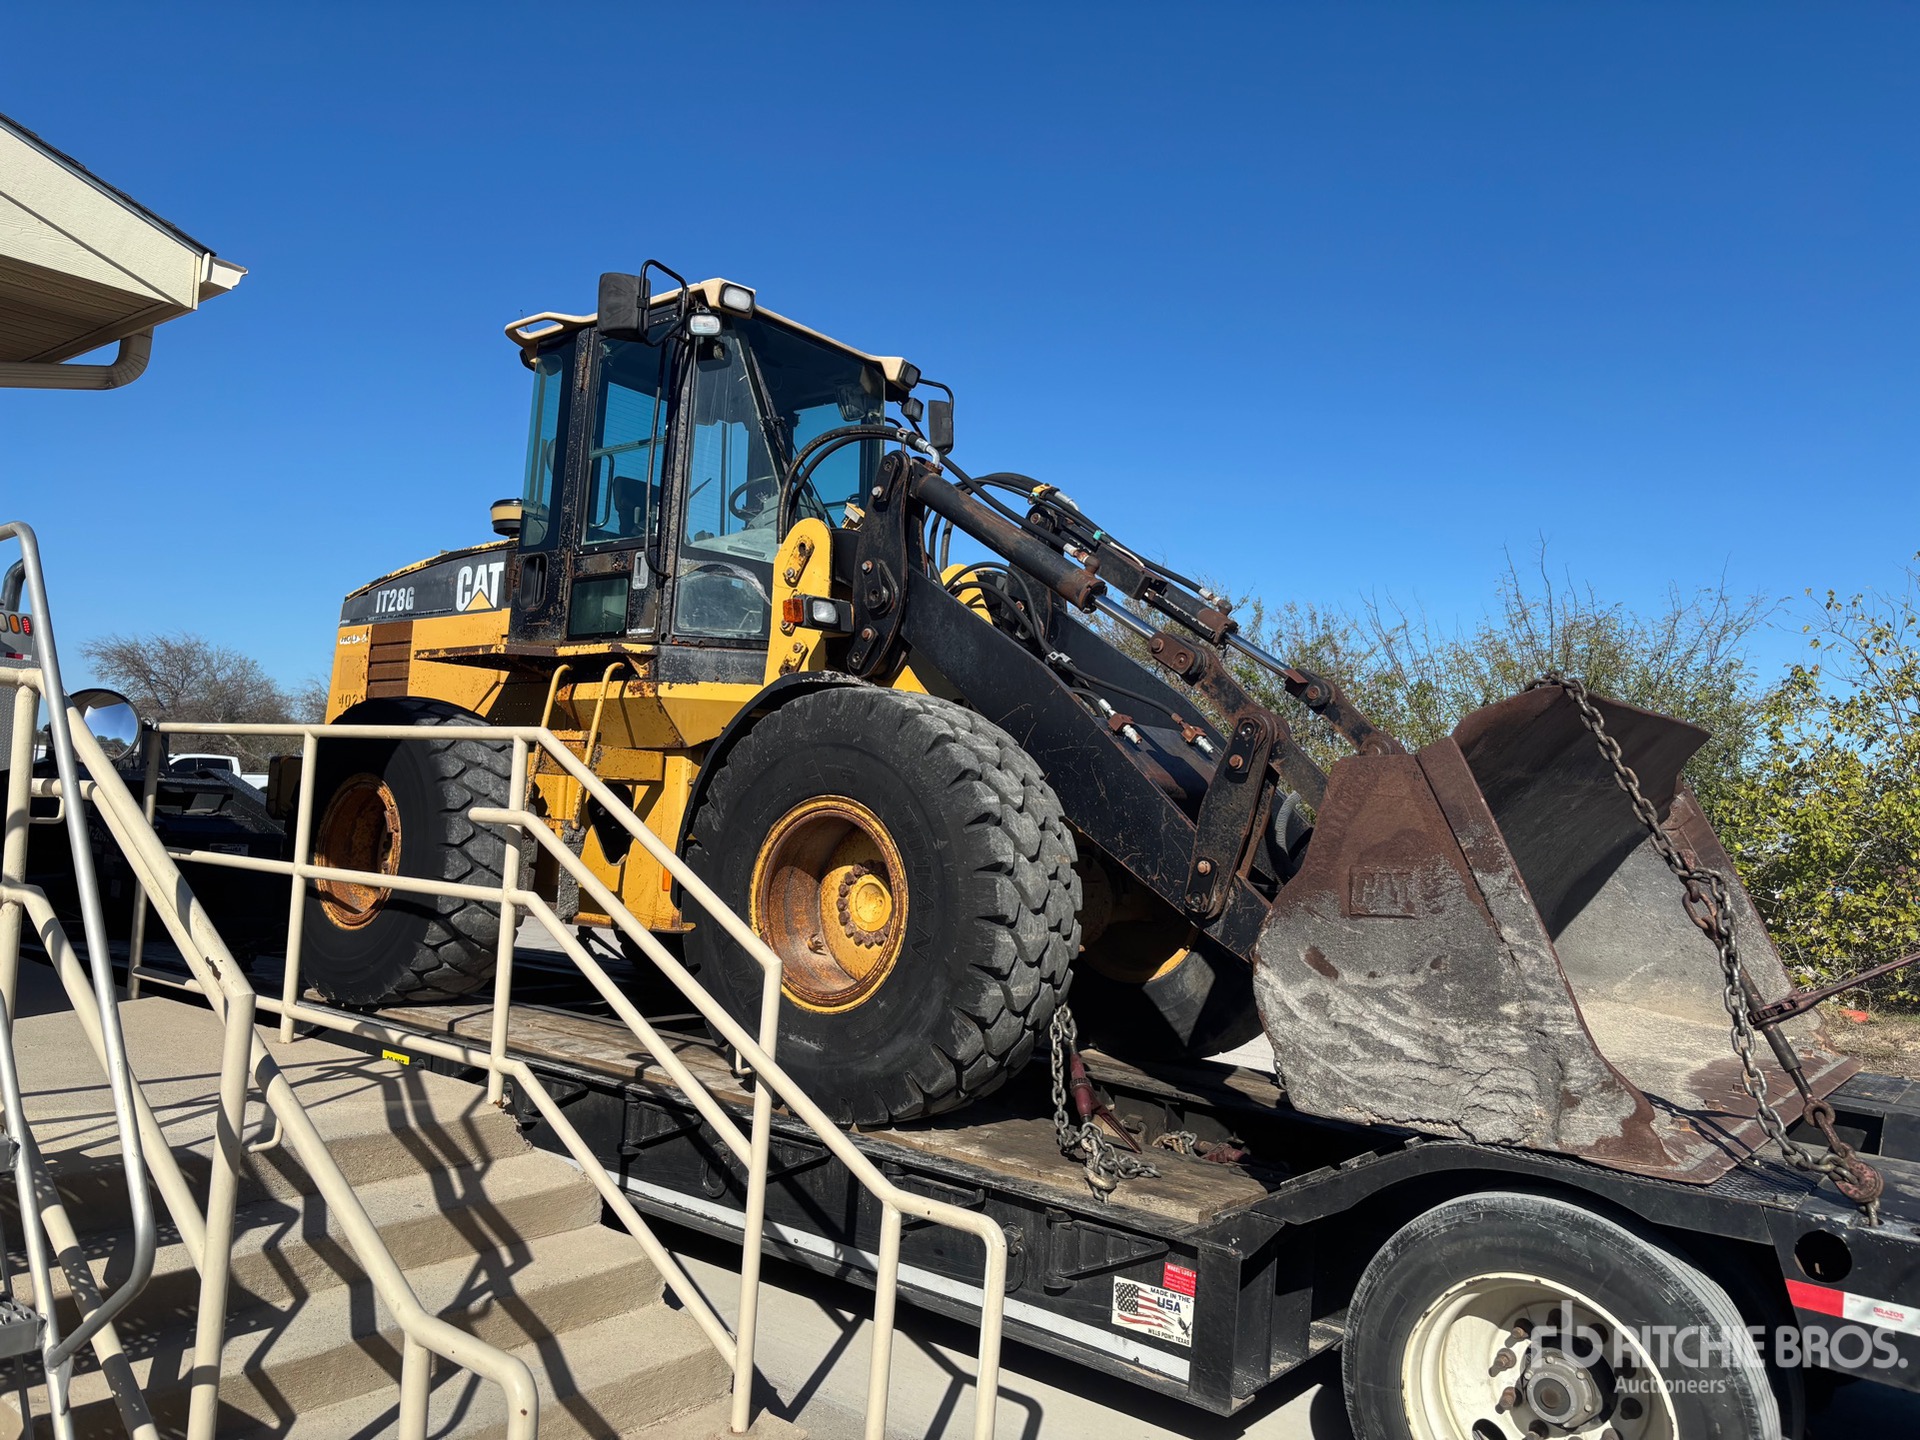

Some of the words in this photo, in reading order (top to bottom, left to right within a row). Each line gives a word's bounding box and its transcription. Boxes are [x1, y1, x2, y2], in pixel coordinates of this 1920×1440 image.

[456, 561, 505, 612] CAT
[375, 586, 415, 614] IT28G
[893, 802, 938, 962] TITAN
[1150, 1287, 1168, 1296] MADE
[1178, 1294, 1191, 1303] THE
[1156, 1296, 1181, 1313] USA
[1873, 1306, 1904, 1319] BRAZOS
[1147, 1328, 1161, 1336] WILLS
[1175, 1336, 1190, 1346] TEXAS
